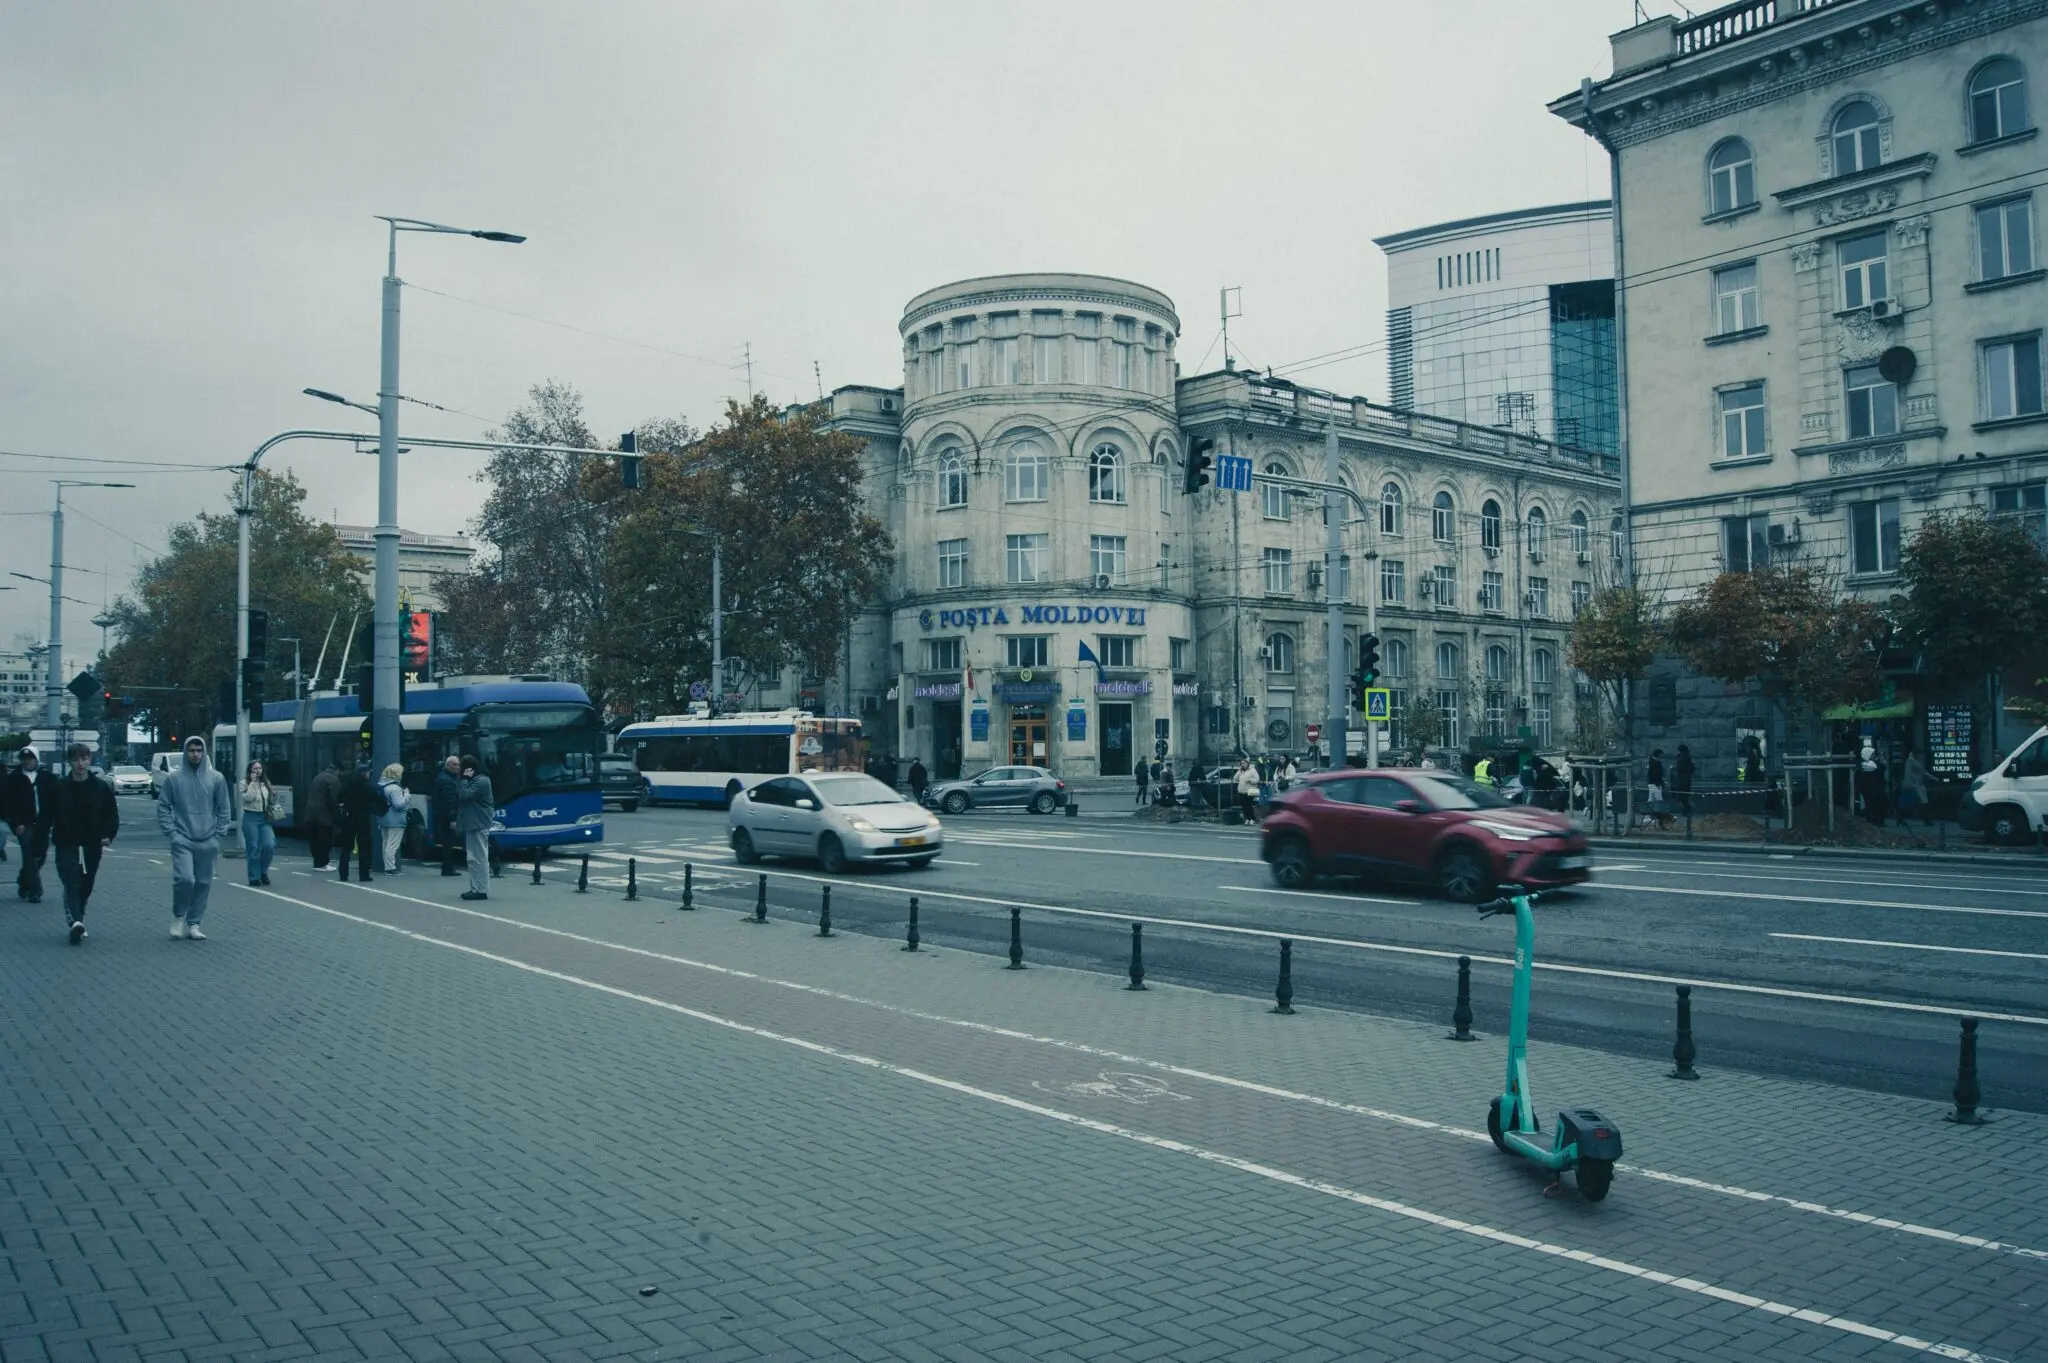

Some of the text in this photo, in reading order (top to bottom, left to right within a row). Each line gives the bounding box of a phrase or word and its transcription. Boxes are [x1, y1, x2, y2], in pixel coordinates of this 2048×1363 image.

[1021, 606, 1145, 626] MOLDOVEI
[915, 683, 960, 697] moldcell
[1094, 680, 1149, 695] moldcell
[1515, 947, 1525, 970] Bolt
